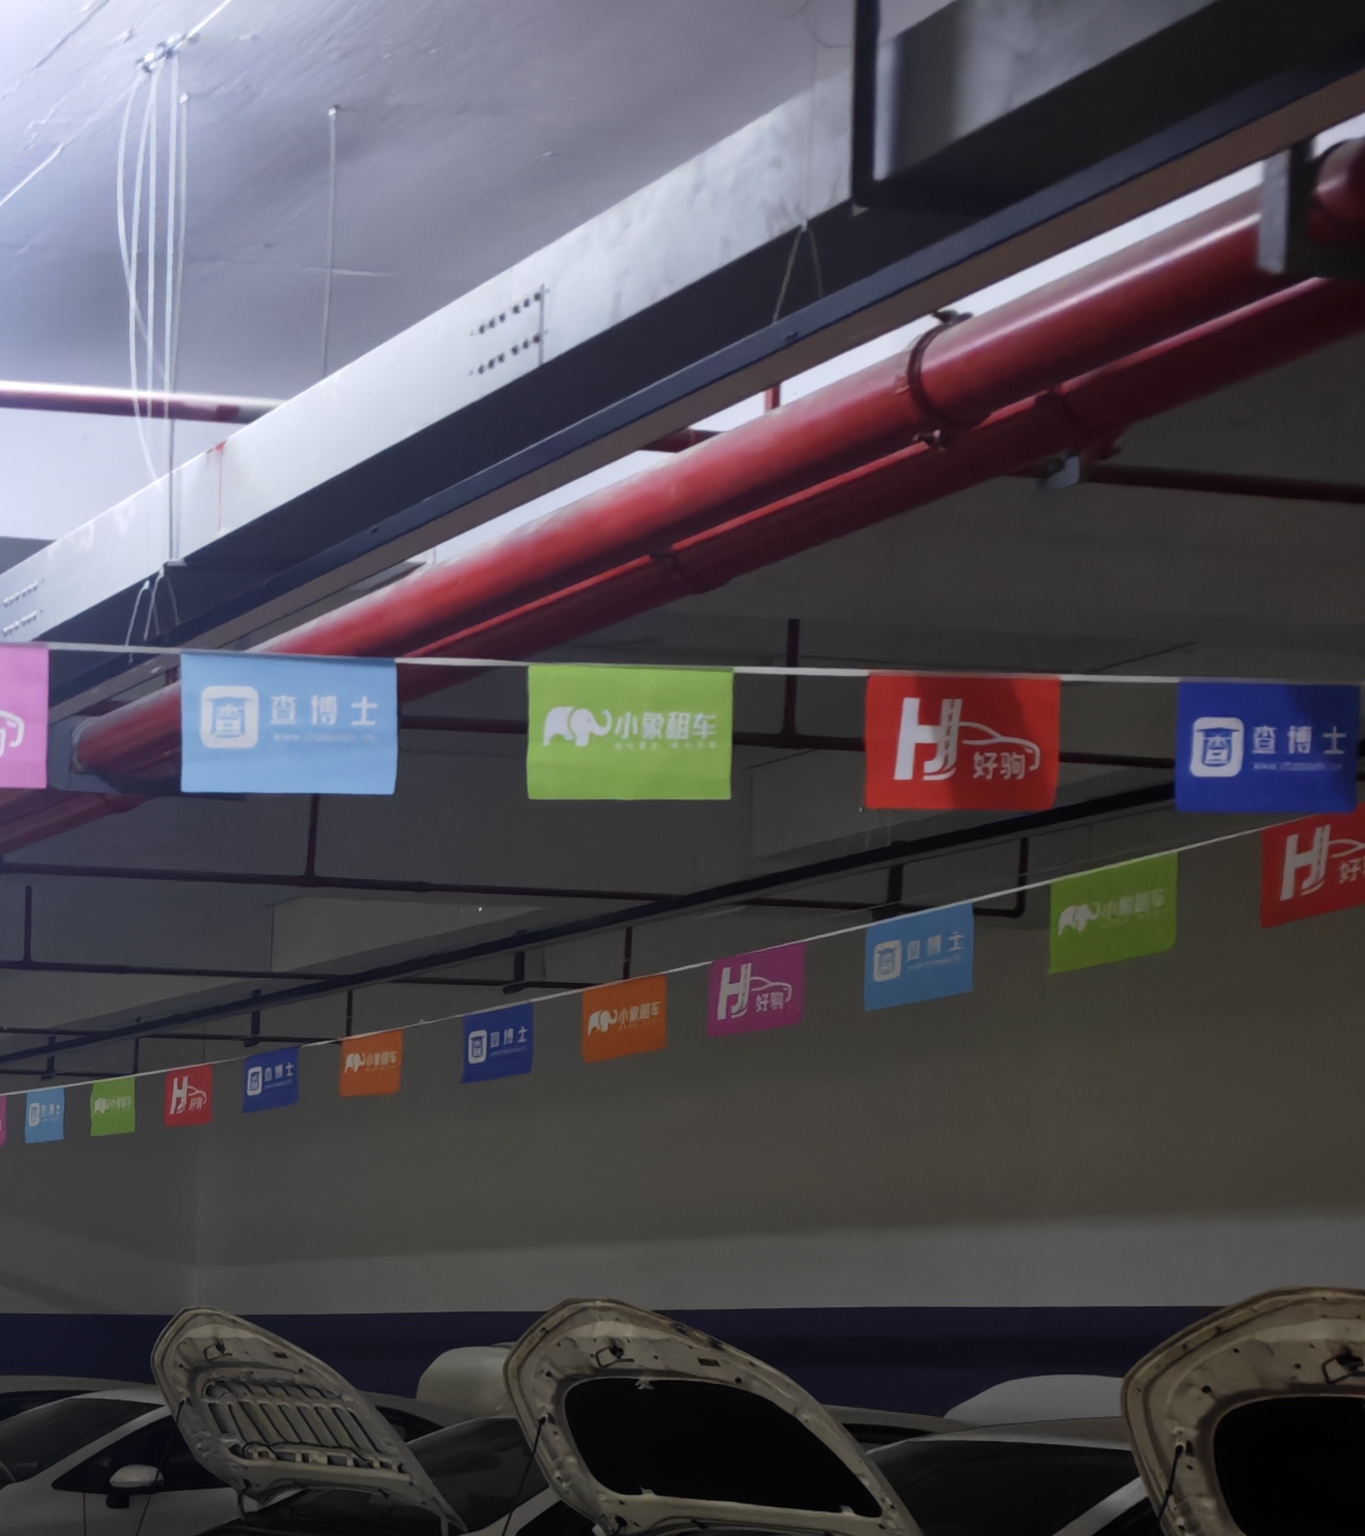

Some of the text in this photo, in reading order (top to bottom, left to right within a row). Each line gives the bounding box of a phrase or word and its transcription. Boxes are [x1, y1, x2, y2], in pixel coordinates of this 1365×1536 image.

[270, 695, 378, 727] 查博士
[615, 711, 717, 740] 小象租车
[1252, 725, 1347, 756] 查博士
[973, 752, 1026, 780] 好驹
